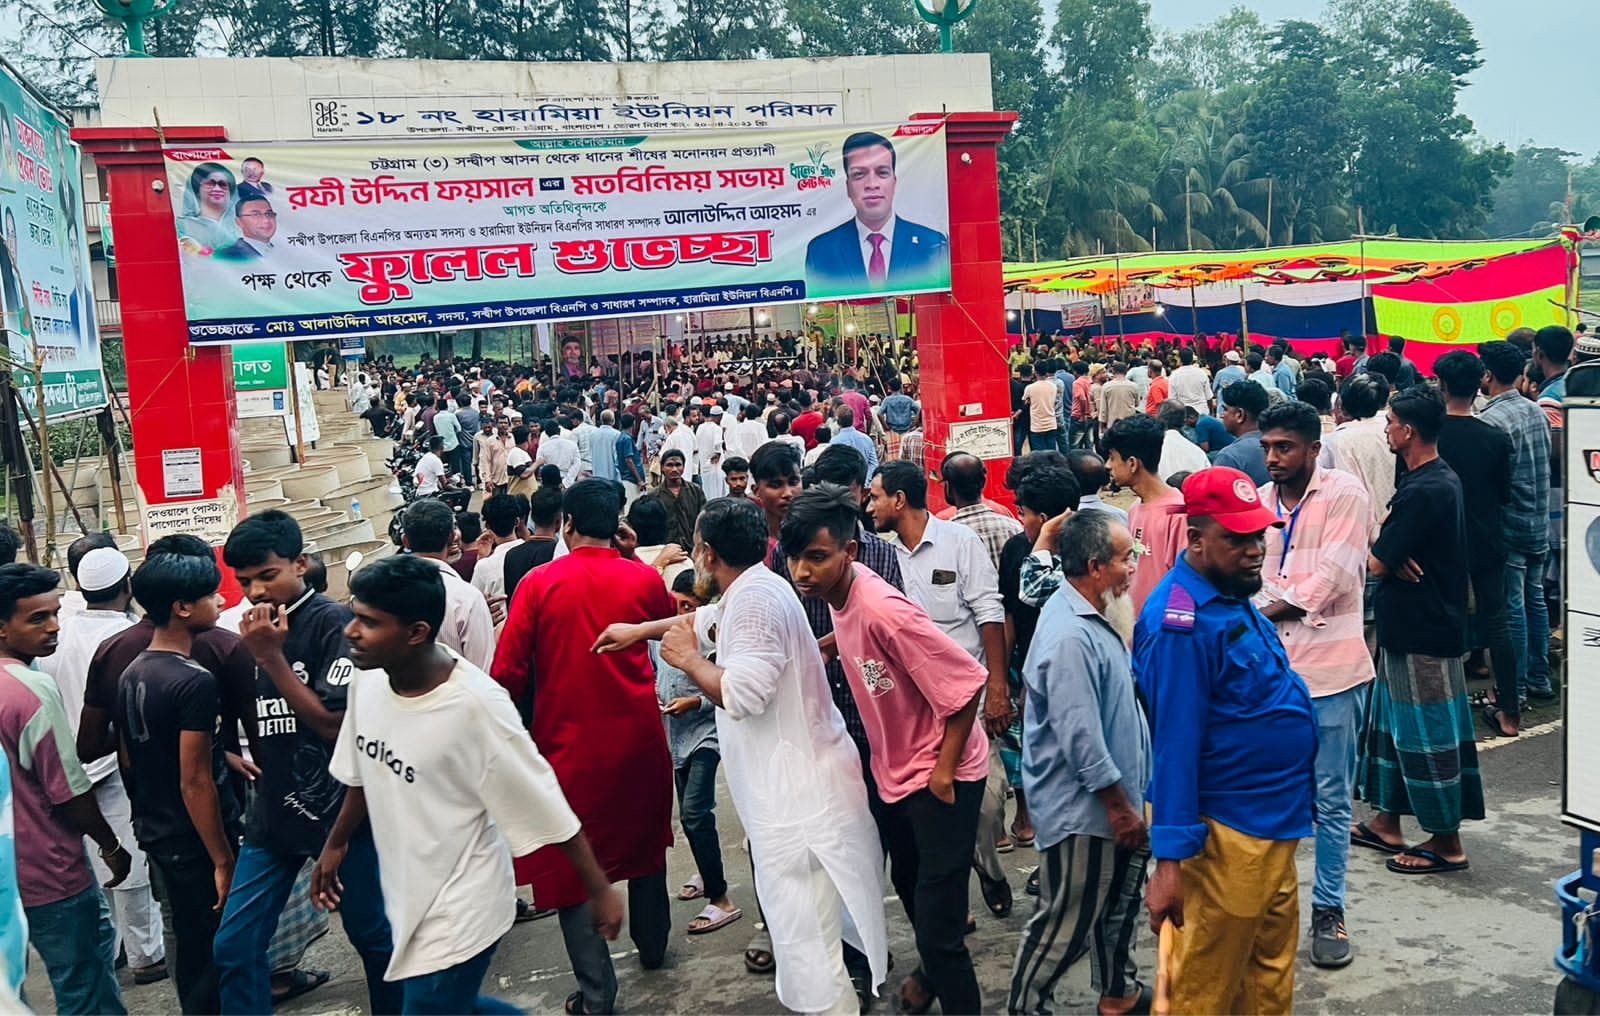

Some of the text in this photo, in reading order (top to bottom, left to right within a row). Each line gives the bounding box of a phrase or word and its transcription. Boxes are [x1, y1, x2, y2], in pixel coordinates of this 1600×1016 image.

[356, 111, 405, 124] ১৮
[416, 110, 463, 124] নং
[471, 104, 603, 121] হারামিয়া
[612, 102, 736, 121] ইউনিয়ন
[745, 101, 838, 118] পরিষদ
[369, 143, 776, 171] চট্টগ্রাম (৩) সন্দ্বীপ আসন থেকে ধানের শীষের মনোনয়ন প্রত্যাশী
[286, 165, 785, 211] রফী উদ্দিন ফয়সাল এর মতবিনিময় সভায়
[317, 232, 358, 246] উপজেলা
[360, 228, 401, 244] বিএনপির
[404, 228, 438, 241] অন্যতম
[440, 227, 466, 239] সদস্য
[468, 228, 476, 237] ও
[480, 222, 516, 238] হারামিয়া
[518, 220, 553, 235] ইউনিয়ন
[555, 218, 593, 233] বিএনপির
[595, 219, 625, 231] সাধারণ
[628, 217, 661, 229] সম্পাদক
[663, 203, 747, 225] আলাউদ্দিন
[749, 203, 802, 221] আহমদ
[503, 205, 536, 218] আগত
[240, 229, 775, 305] পক্ষ থেকে ফুলেল শুভেচ্ছা
[265, 320, 296, 334] মোঃ
[298, 314, 370, 332] আলাউদ্দিন
[373, 311, 433, 328] আহমেদ,
[436, 311, 469, 322] সদস্য,
[505, 304, 547, 318] উপজেলা
[550, 300, 587, 314] বিএনপি
[591, 302, 599, 311] ও
[601, 299, 636, 311] সাধারণ
[638, 296, 680, 309] সম্পাদক,
[682, 291, 720, 305] হারামিয়া
[722, 288, 758, 302] ইউনিয়ন
[329, 658, 353, 686] hp
